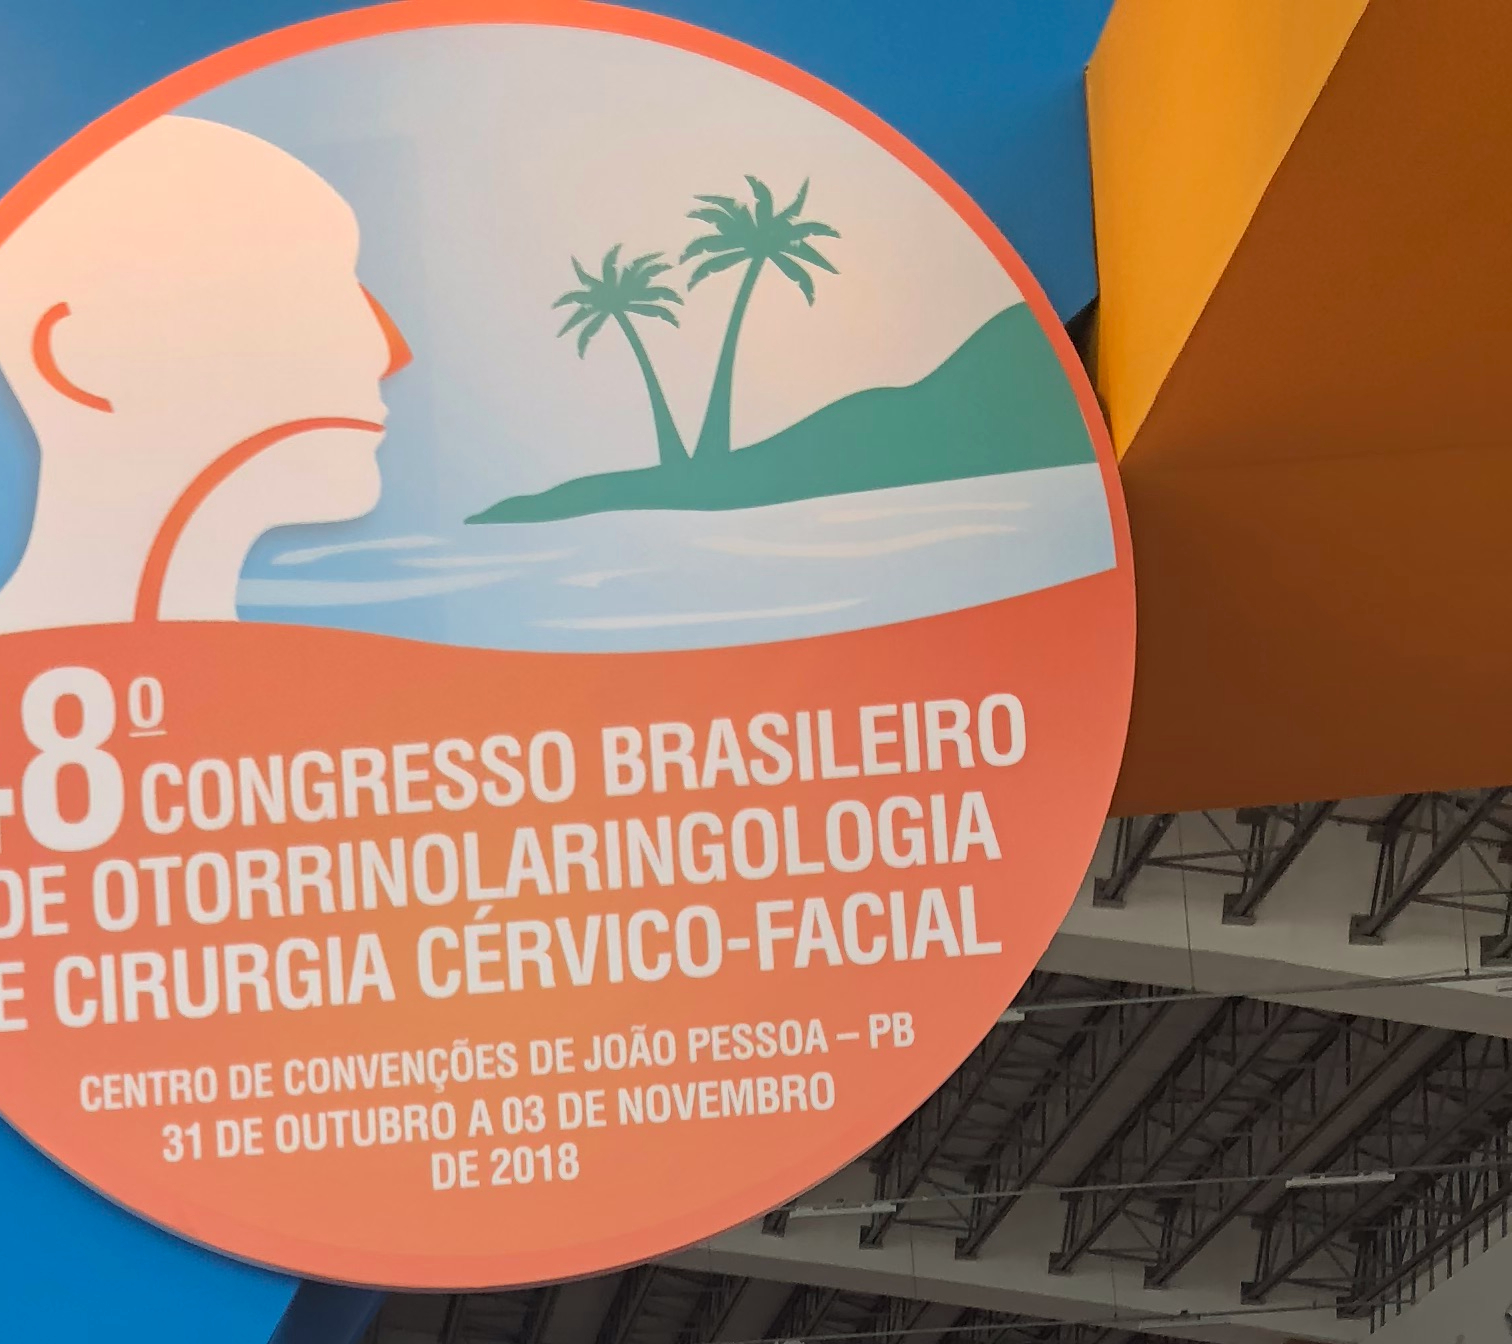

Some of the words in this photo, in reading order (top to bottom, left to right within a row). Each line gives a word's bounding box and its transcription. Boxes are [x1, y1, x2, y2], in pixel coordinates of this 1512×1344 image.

[141, 731, 576, 834] CONGRESSO
[601, 694, 1026, 796] BRASILEIRO
[92, 791, 1002, 932] OTORRINOLARINGOLOGIA
[53, 933, 396, 1028] CIRURGIA
[417, 885, 1002, 999] CÉRVICO-FACIAL
[79, 1066, 218, 1112] CENTRO
[229, 1062, 274, 1100] DE
[283, 1040, 518, 1098] CONVENÇÕES
[529, 1038, 575, 1076] DE
[583, 1025, 677, 1072] JOÃO
[688, 1019, 829, 1063] PESSOA
[868, 1012, 915, 1049] PB
[162, 1121, 202, 1163] 31
[215, 1117, 264, 1158] DE
[275, 1101, 456, 1153] OUTUBRO
[468, 1099, 491, 1137] A
[500, 1094, 546, 1134] 03
[557, 1089, 607, 1130] DE
[617, 1071, 835, 1125] NOVEMBRO
[431, 1150, 480, 1191] DE
[490, 1142, 580, 1186] 2018
